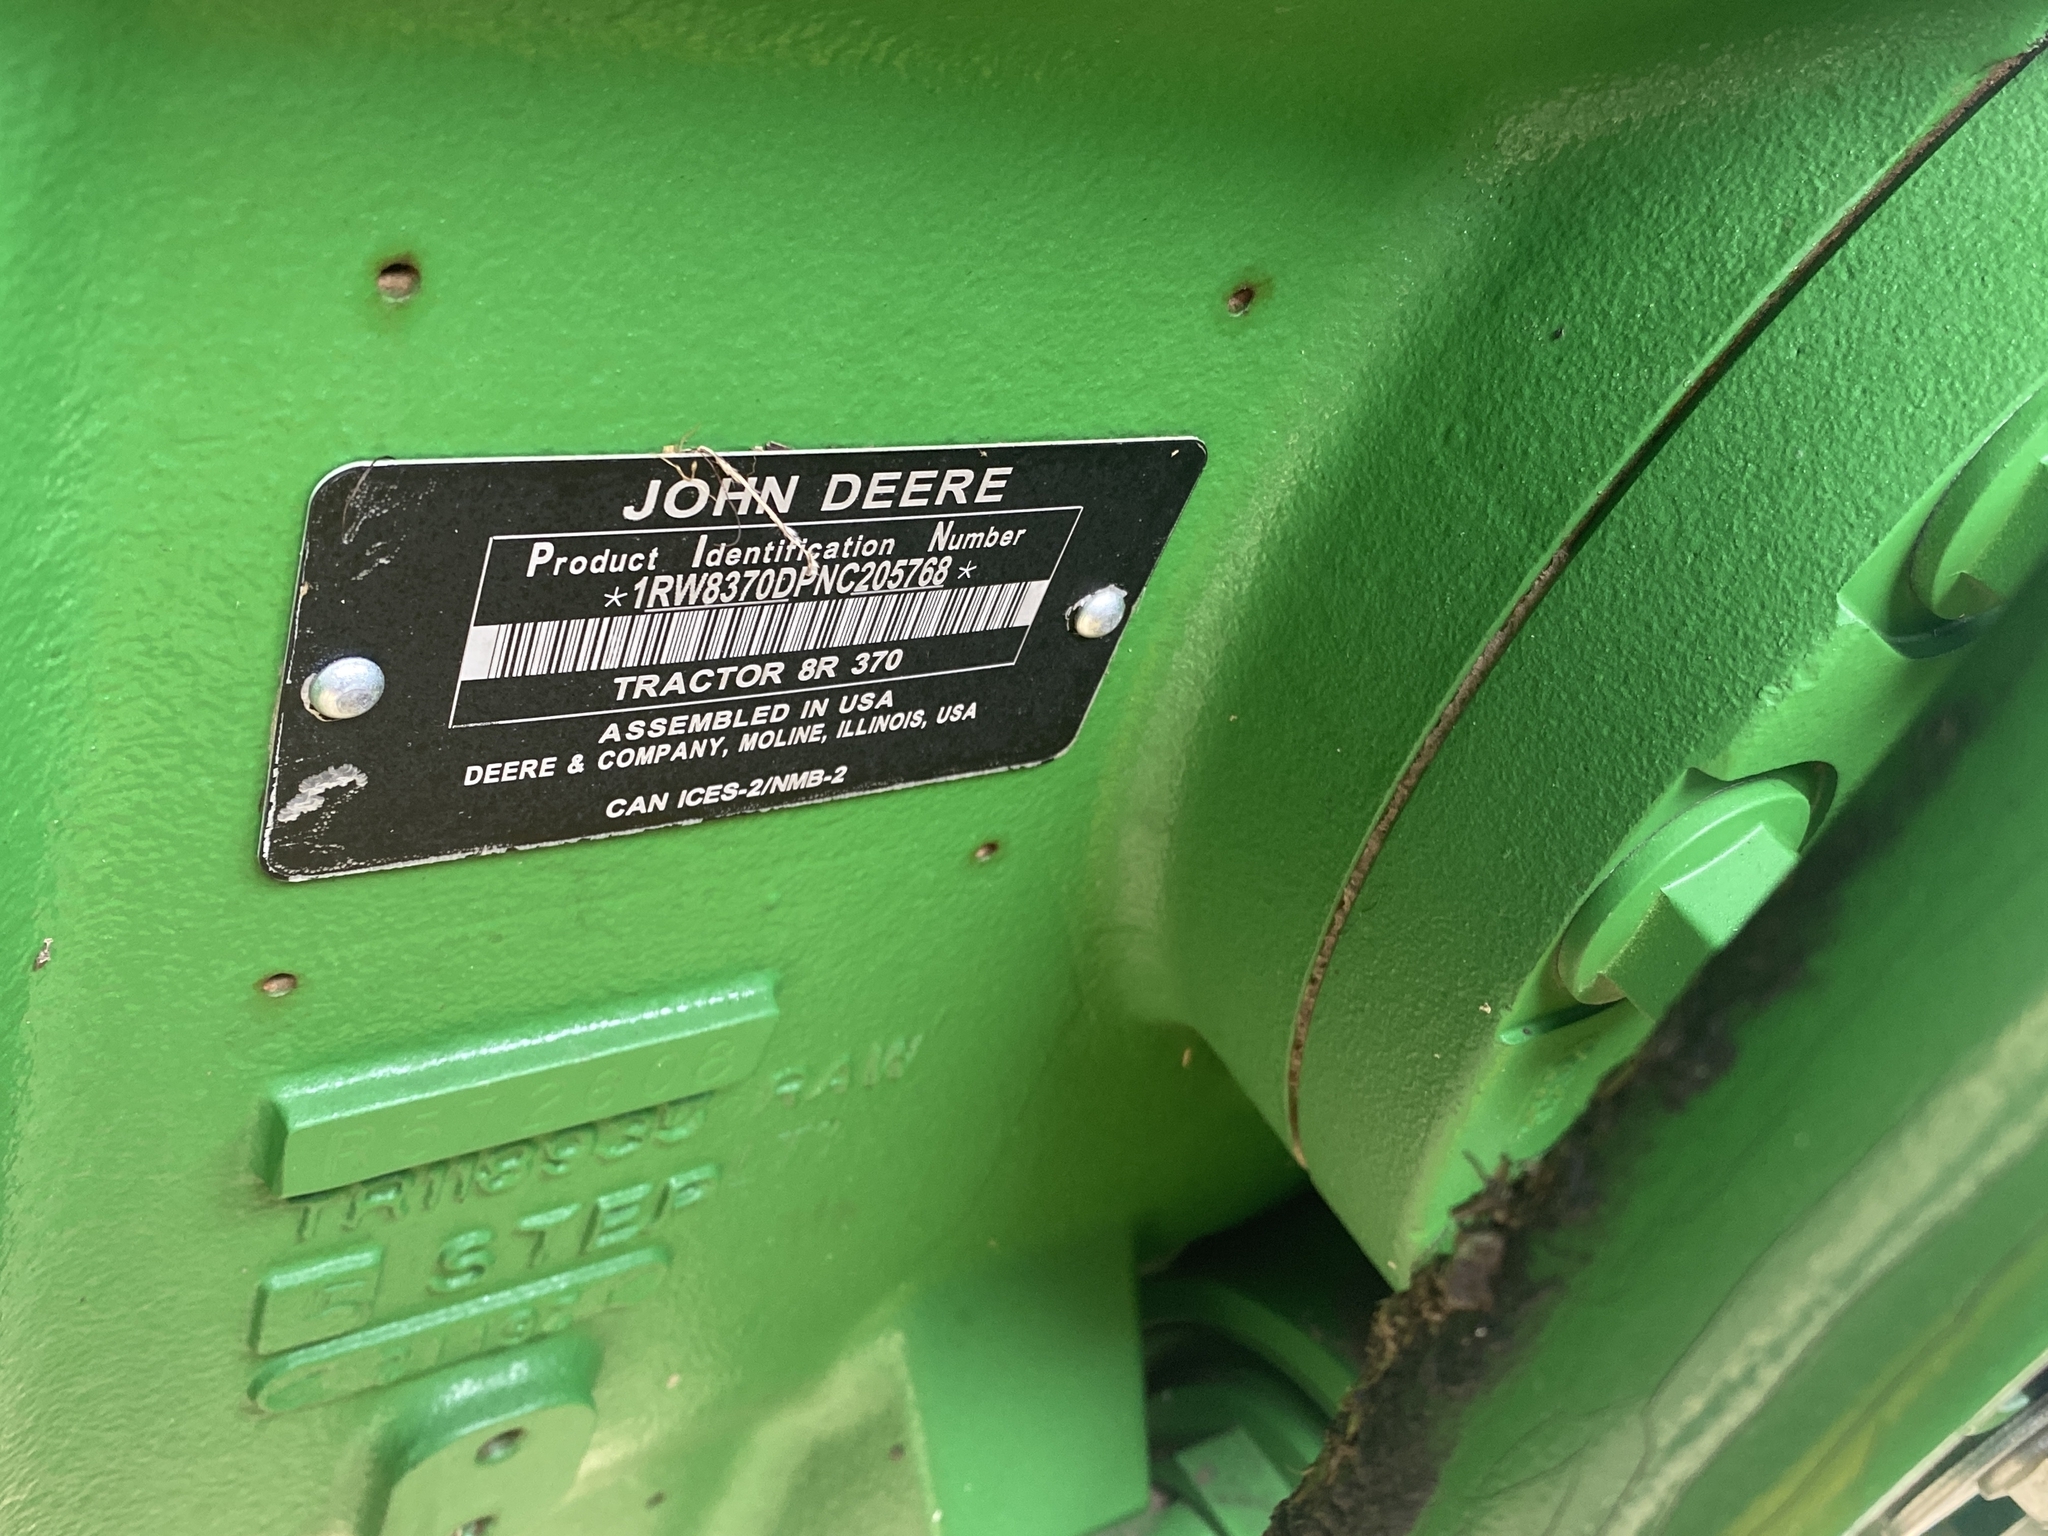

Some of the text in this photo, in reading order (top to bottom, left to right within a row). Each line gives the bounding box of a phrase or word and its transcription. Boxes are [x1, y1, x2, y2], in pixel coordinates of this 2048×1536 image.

[622, 466, 1013, 521] JOHN DEERE
[526, 520, 1026, 577] Product Identification Number
[613, 648, 903, 701] TRACTOR 8R 370
[463, 701, 977, 786] DEERE & COMPANY, MOLINE, ILLINOIS, USA
[597, 689, 894, 744] ASSEMBLED IN USA
[605, 765, 848, 818] CAN ICES-2/NMB-2
